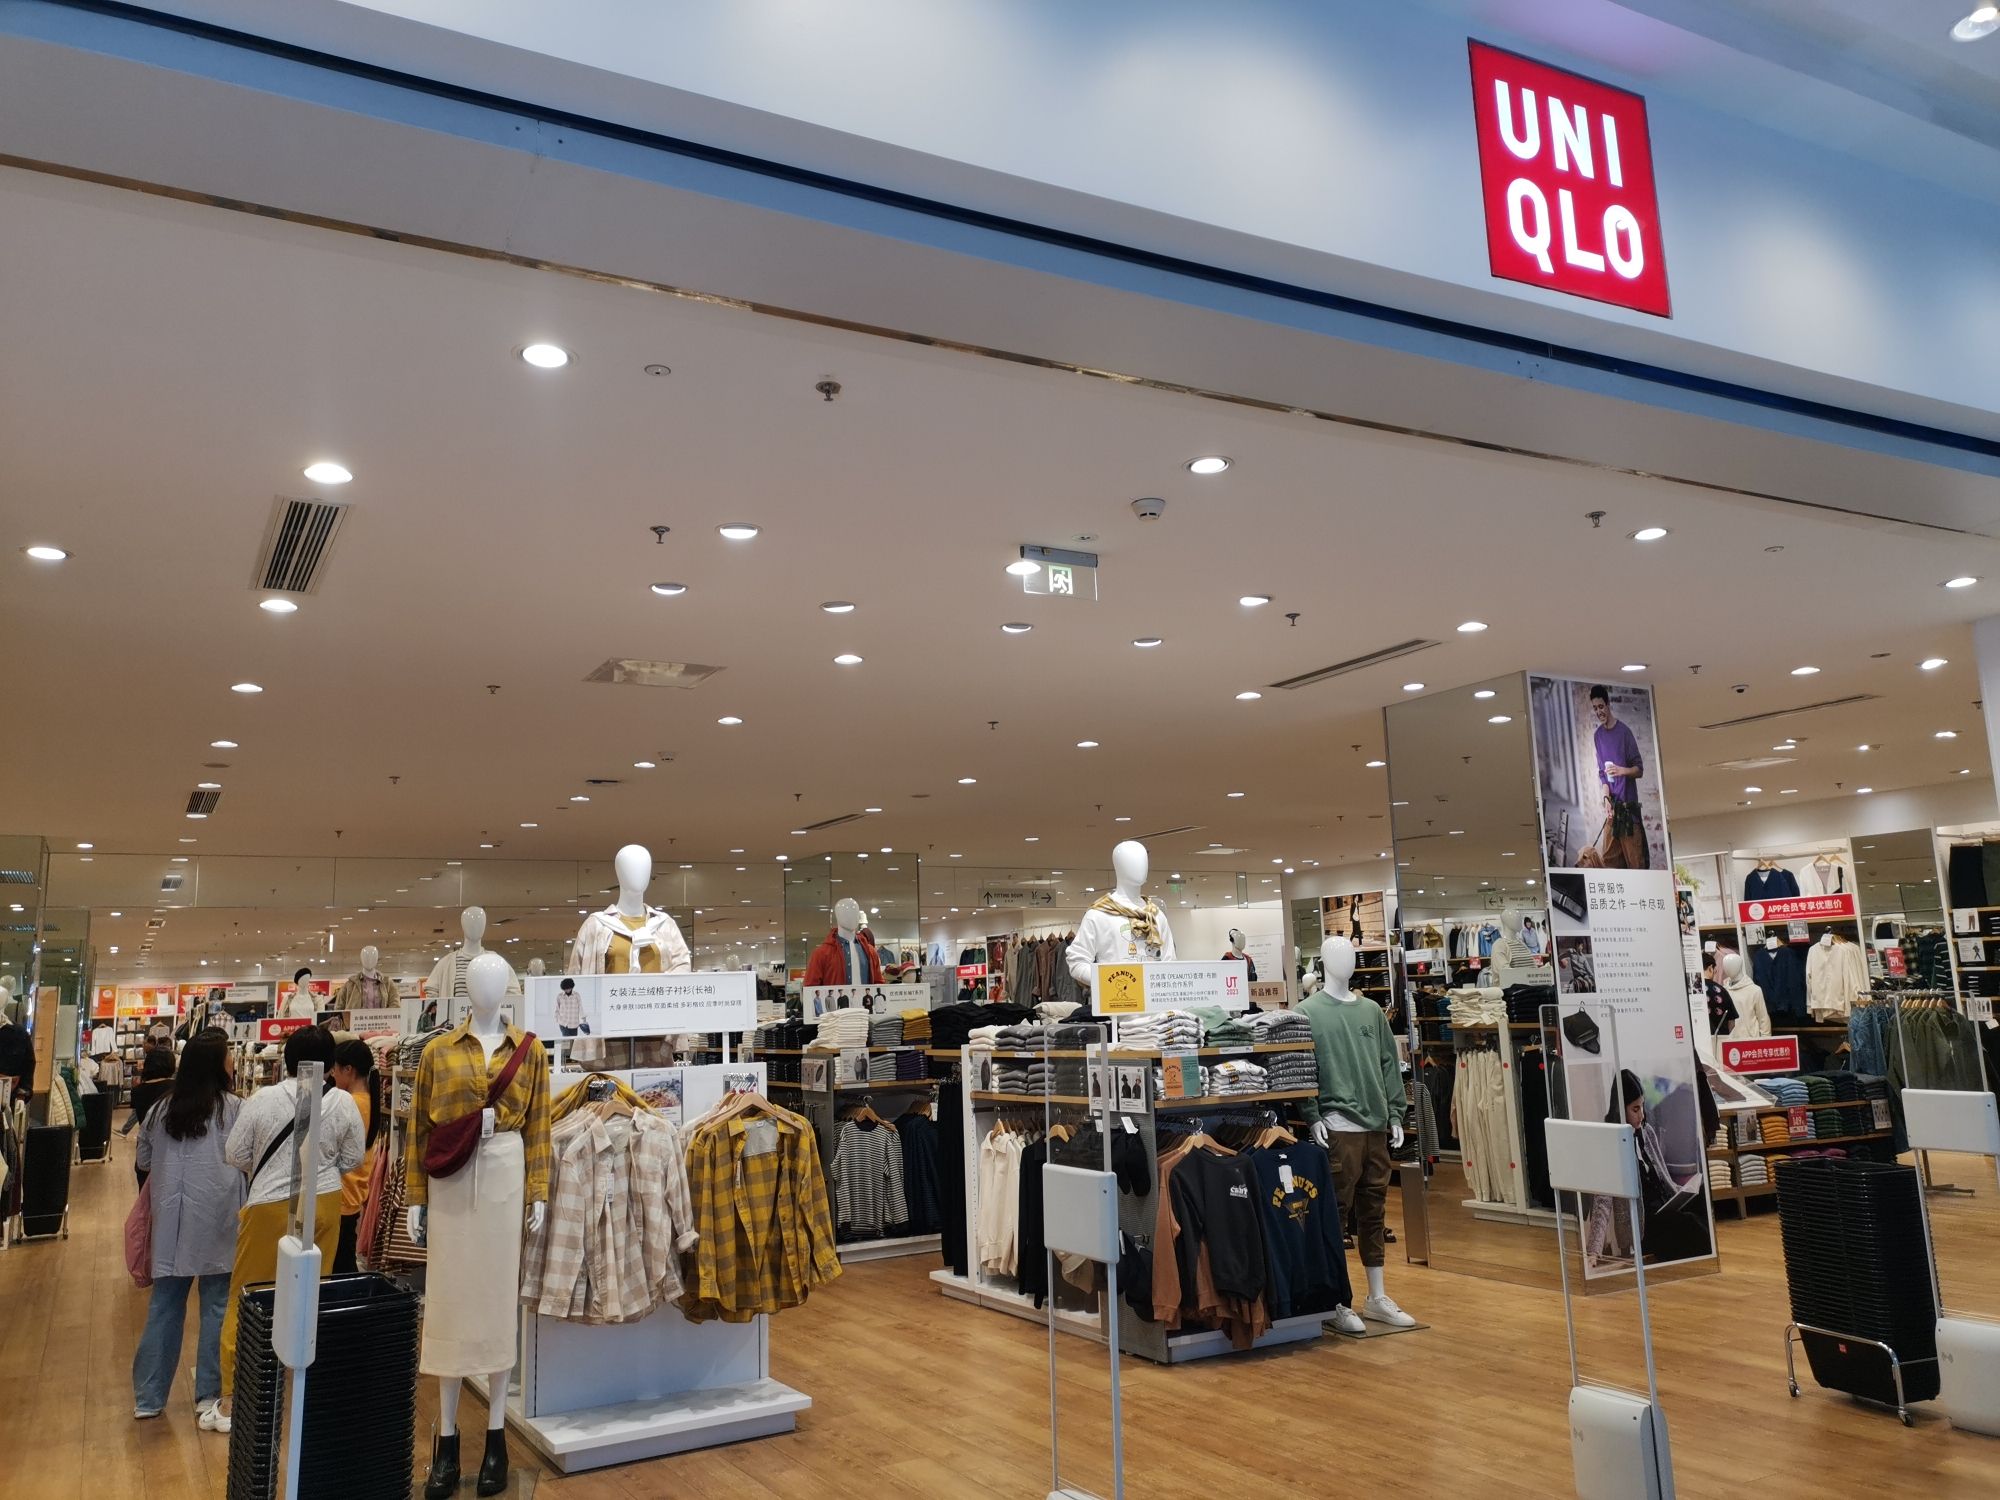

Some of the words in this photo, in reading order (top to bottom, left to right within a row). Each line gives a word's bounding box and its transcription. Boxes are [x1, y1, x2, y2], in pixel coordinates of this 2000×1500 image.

[1494, 78, 1623, 187] UNI
[1506, 177, 1644, 279] QLO
[1589, 882, 1625, 894] 日常服饰
[1590, 898, 1626, 910] 品质之作
[1630, 898, 1665, 910] 一件尽现
[1768, 899, 1842, 913] APP会员专享优惠价
[1108, 970, 1136, 983] PEANUTS
[1225, 976, 1238, 988] UT
[1226, 988, 1239, 996] 2023
[1250, 987, 1279, 997] 新品推荐
[1741, 1046, 1791, 1059] APP会员专享优惠价
[1272, 1176, 1318, 1207] PENUTS
